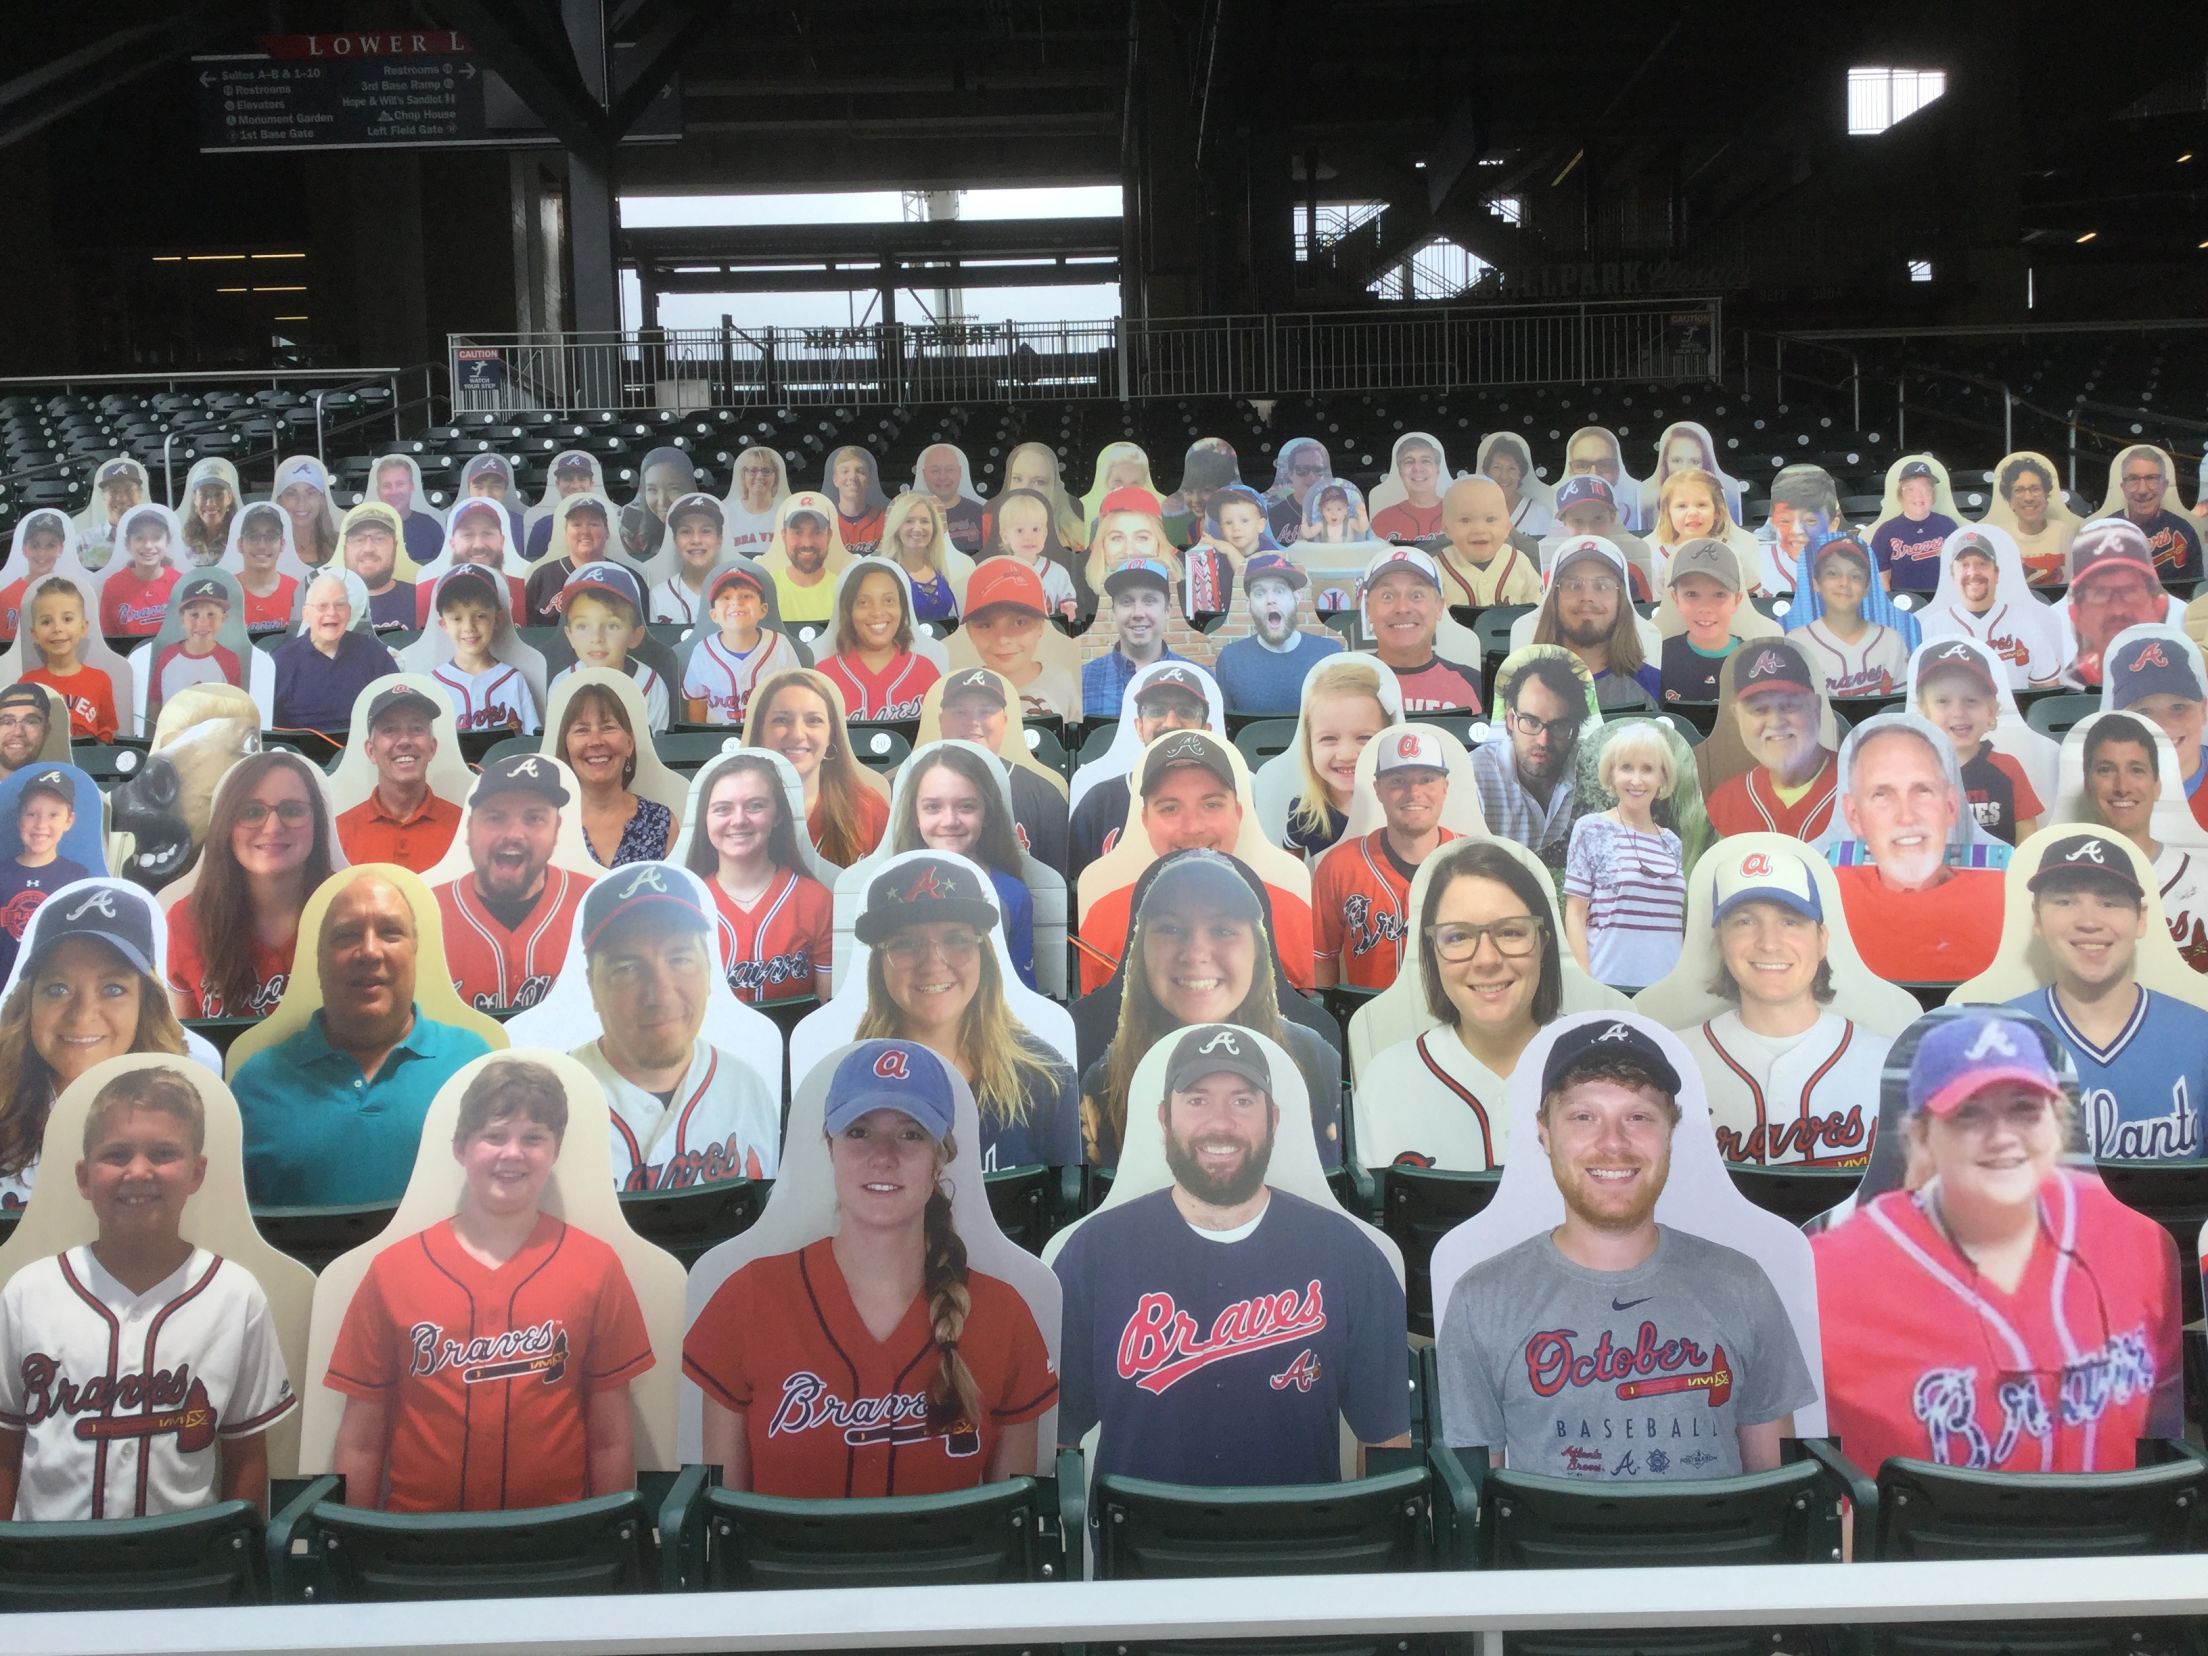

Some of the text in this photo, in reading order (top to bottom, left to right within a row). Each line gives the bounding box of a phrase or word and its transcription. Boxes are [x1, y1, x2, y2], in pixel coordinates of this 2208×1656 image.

[308, 35, 427, 55] LOWER
[222, 71, 253, 81] Suites
[283, 69, 290, 78] &
[384, 65, 439, 75] Restrooms
[236, 85, 291, 95] Restrooms
[361, 80, 441, 91] 3rd Base Ramp
[237, 101, 285, 110] Elevators
[343, 97, 367, 107] Hope
[370, 97, 377, 105] &
[407, 95, 442, 104] Sandlot
[238, 113, 333, 125] Monument Garden
[394, 109, 456, 121] Chop House
[240, 128, 314, 140] 1st Base Gate
[368, 124, 443, 136] Left Field Gate
[1670, 314, 1709, 323] CAUTION
[459, 350, 498, 359] CAUTION
[112, 463, 128, 475] A
[295, 463, 311, 474] A
[1561, 480, 1578, 499] A
[1691, 543, 1717, 560] A
[2094, 533, 2124, 555] A
[582, 568, 605, 581] A
[194, 584, 214, 596] A
[1939, 644, 1970, 661] A
[2129, 642, 2169, 672] A
[1159, 667, 1183, 682] A
[1749, 650, 1785, 678] A
[963, 670, 985, 686] A
[1825, 665, 1883, 689] raves
[457, 702, 505, 730] aves
[849, 695, 923, 720] aves
[1166, 734, 1205, 757] A
[1397, 734, 1422, 760] a
[39, 771, 63, 783] A
[507, 758, 539, 779] A
[2065, 840, 2104, 864] A
[1740, 853, 1773, 878] a
[619, 865, 667, 900] A
[906, 865, 947, 902] A
[66, 889, 116, 922] A
[727, 951, 808, 990] aves
[1597, 1023, 1629, 1042] A
[1965, 1019, 2017, 1061] A
[1198, 1031, 1240, 1056] A
[872, 1049, 911, 1080] a
[1714, 1104, 1864, 1163] raves
[614, 1131, 740, 1191] aves
[1117, 1280, 1327, 1379] Braves
[409, 1319, 553, 1377] Braves
[1525, 1321, 1708, 1397] October
[1270, 1349, 1313, 1392] A
[22, 1353, 189, 1426] Braves
[768, 1371, 928, 1438] Brave
[1557, 1417, 1718, 1438] BASEBALL
[1611, 1449, 1637, 1476] A
